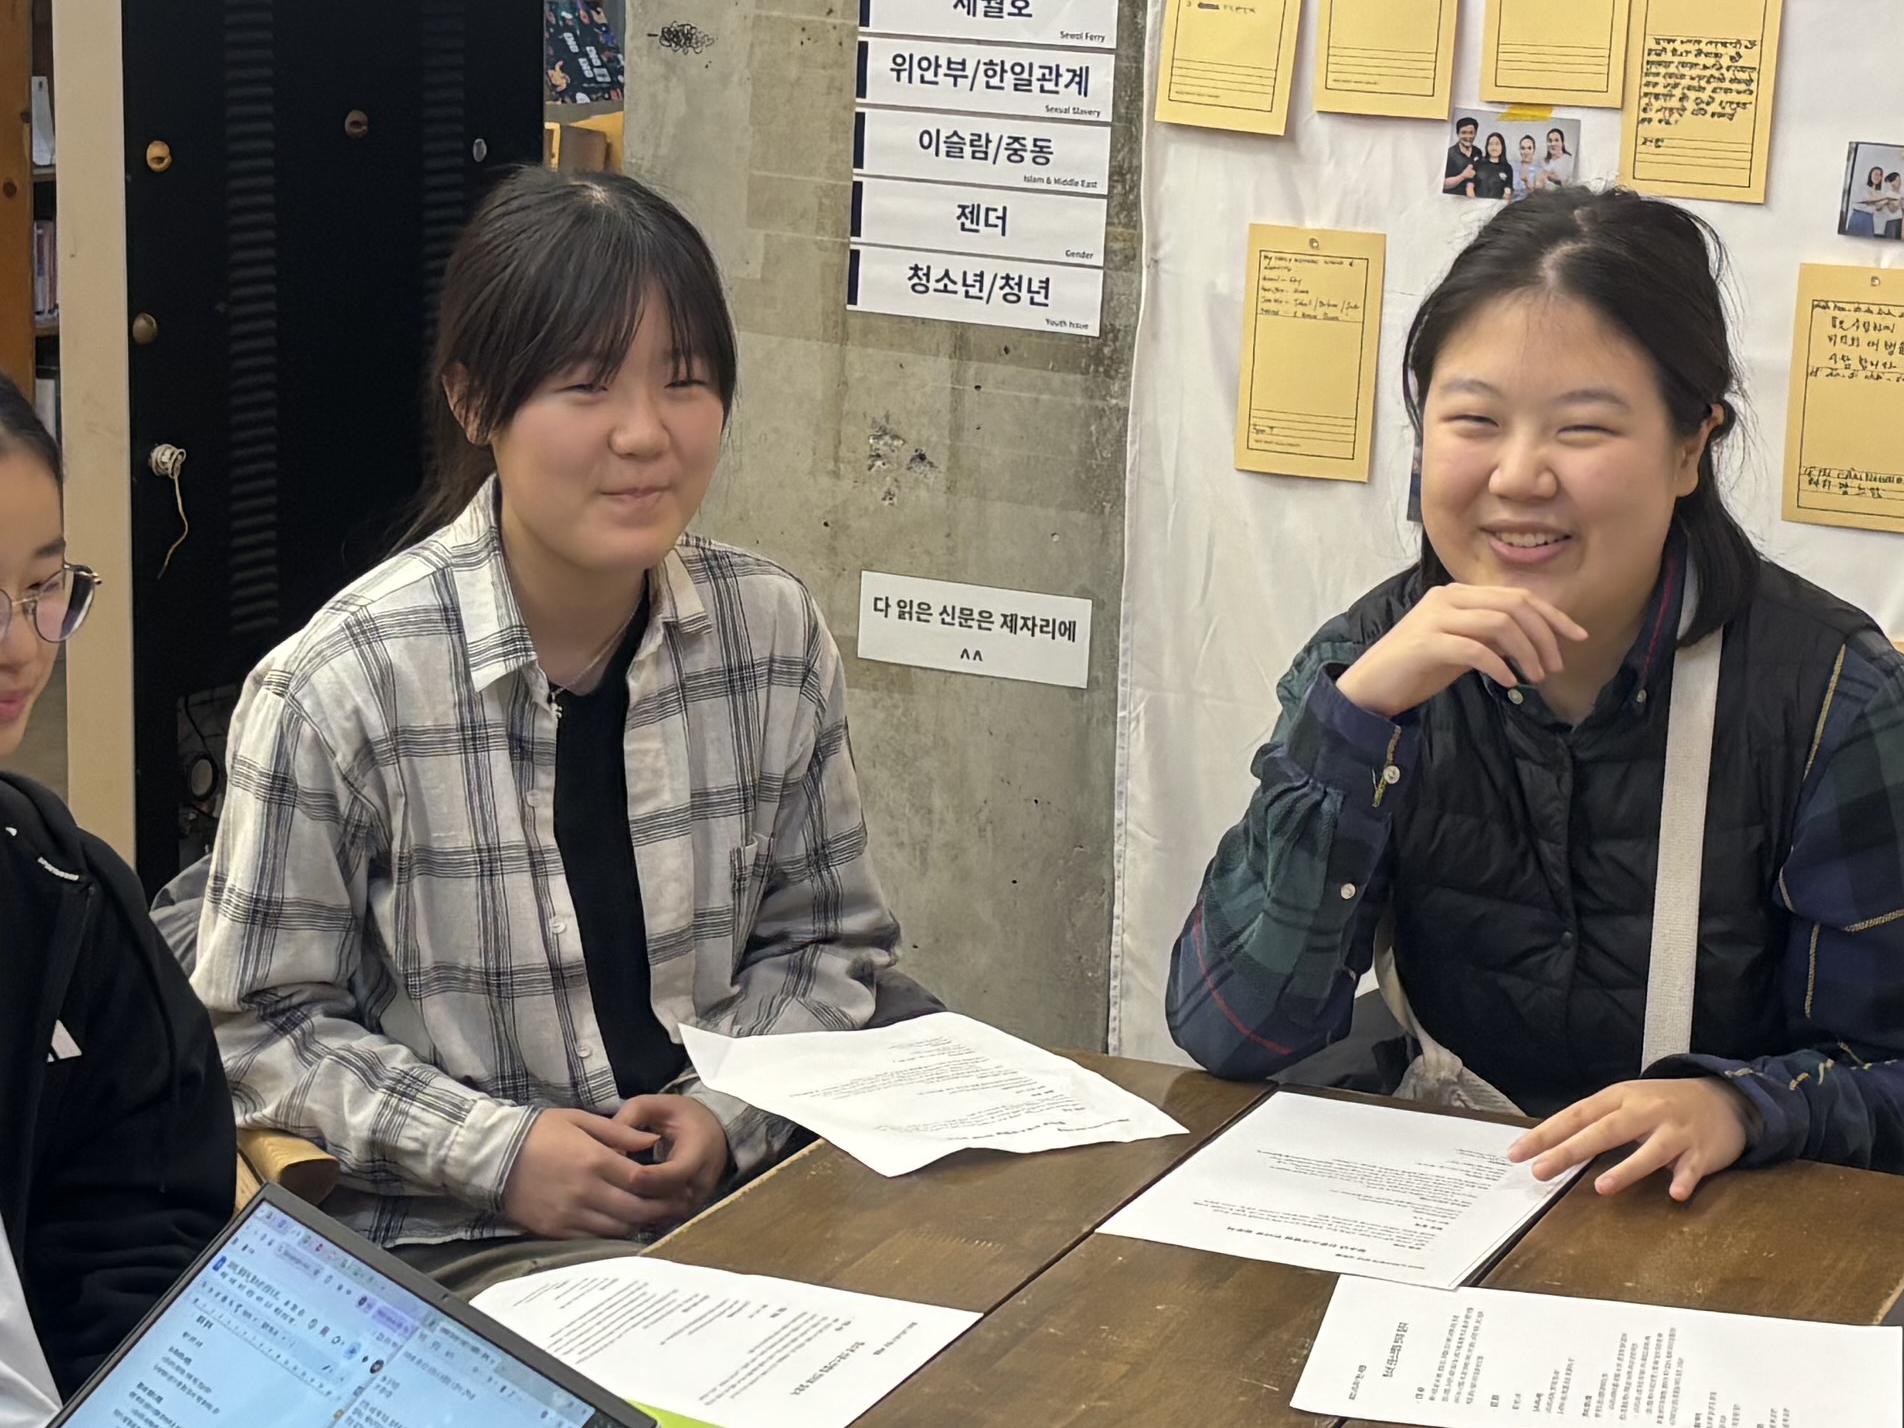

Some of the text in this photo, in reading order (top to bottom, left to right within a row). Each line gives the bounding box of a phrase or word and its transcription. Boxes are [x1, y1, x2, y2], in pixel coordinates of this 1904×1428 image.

[890, 53, 1089, 97] 위안부/한일관계
[920, 129, 1053, 166] 이슬람/중동
[956, 204, 1007, 236] 젠더
[908, 264, 1050, 307] 청소년/청년
[874, 596, 1076, 642] 다 읽은 신문은 제자리에
